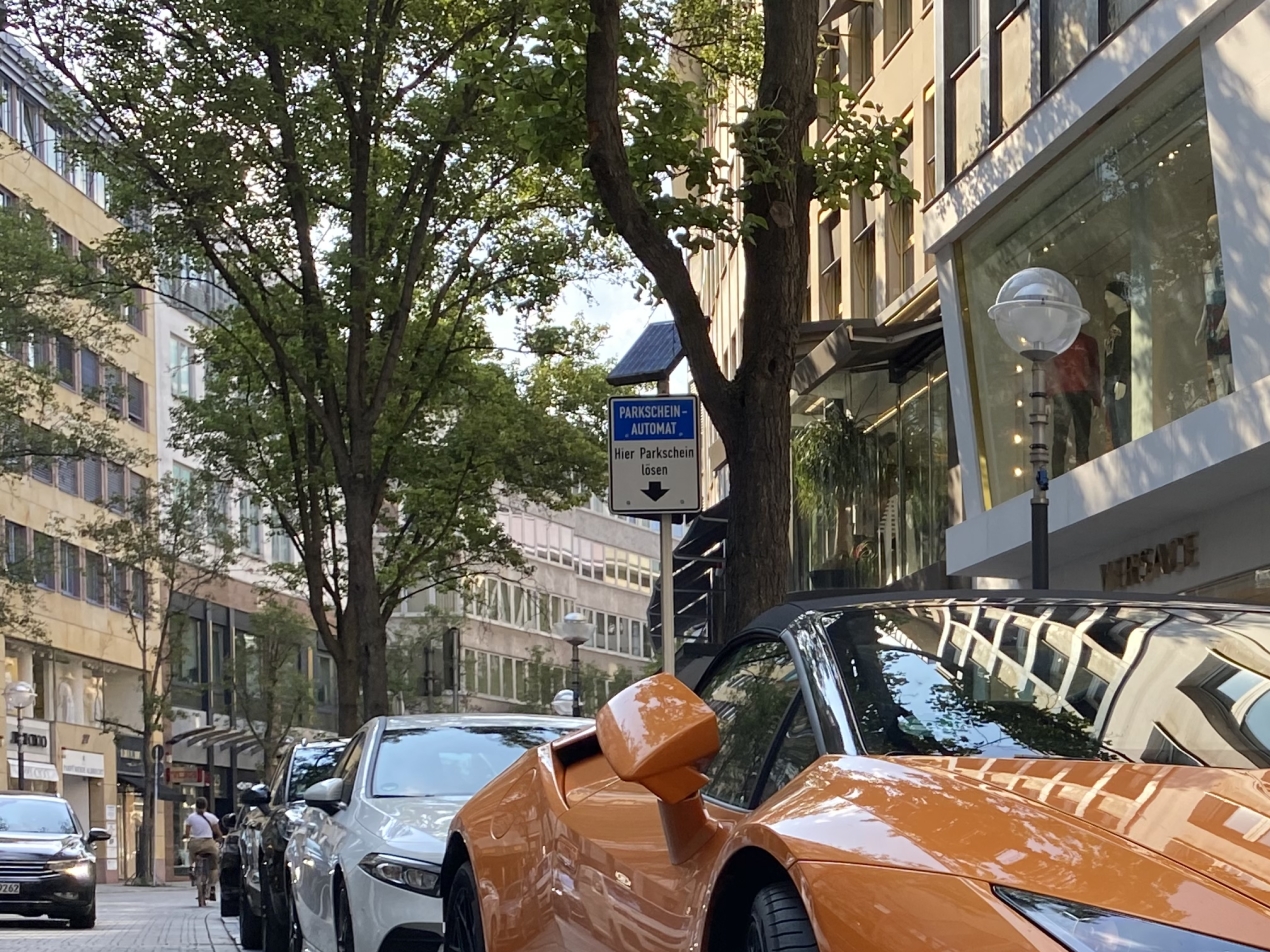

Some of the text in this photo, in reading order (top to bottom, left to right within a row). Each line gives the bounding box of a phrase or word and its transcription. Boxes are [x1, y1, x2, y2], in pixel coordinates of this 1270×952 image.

[619, 405, 688, 418] PARKSCHEIN-
[631, 422, 677, 435] AUTOMAT
[614, 446, 694, 460] Hier Parkschein
[641, 463, 668, 476] lösen
